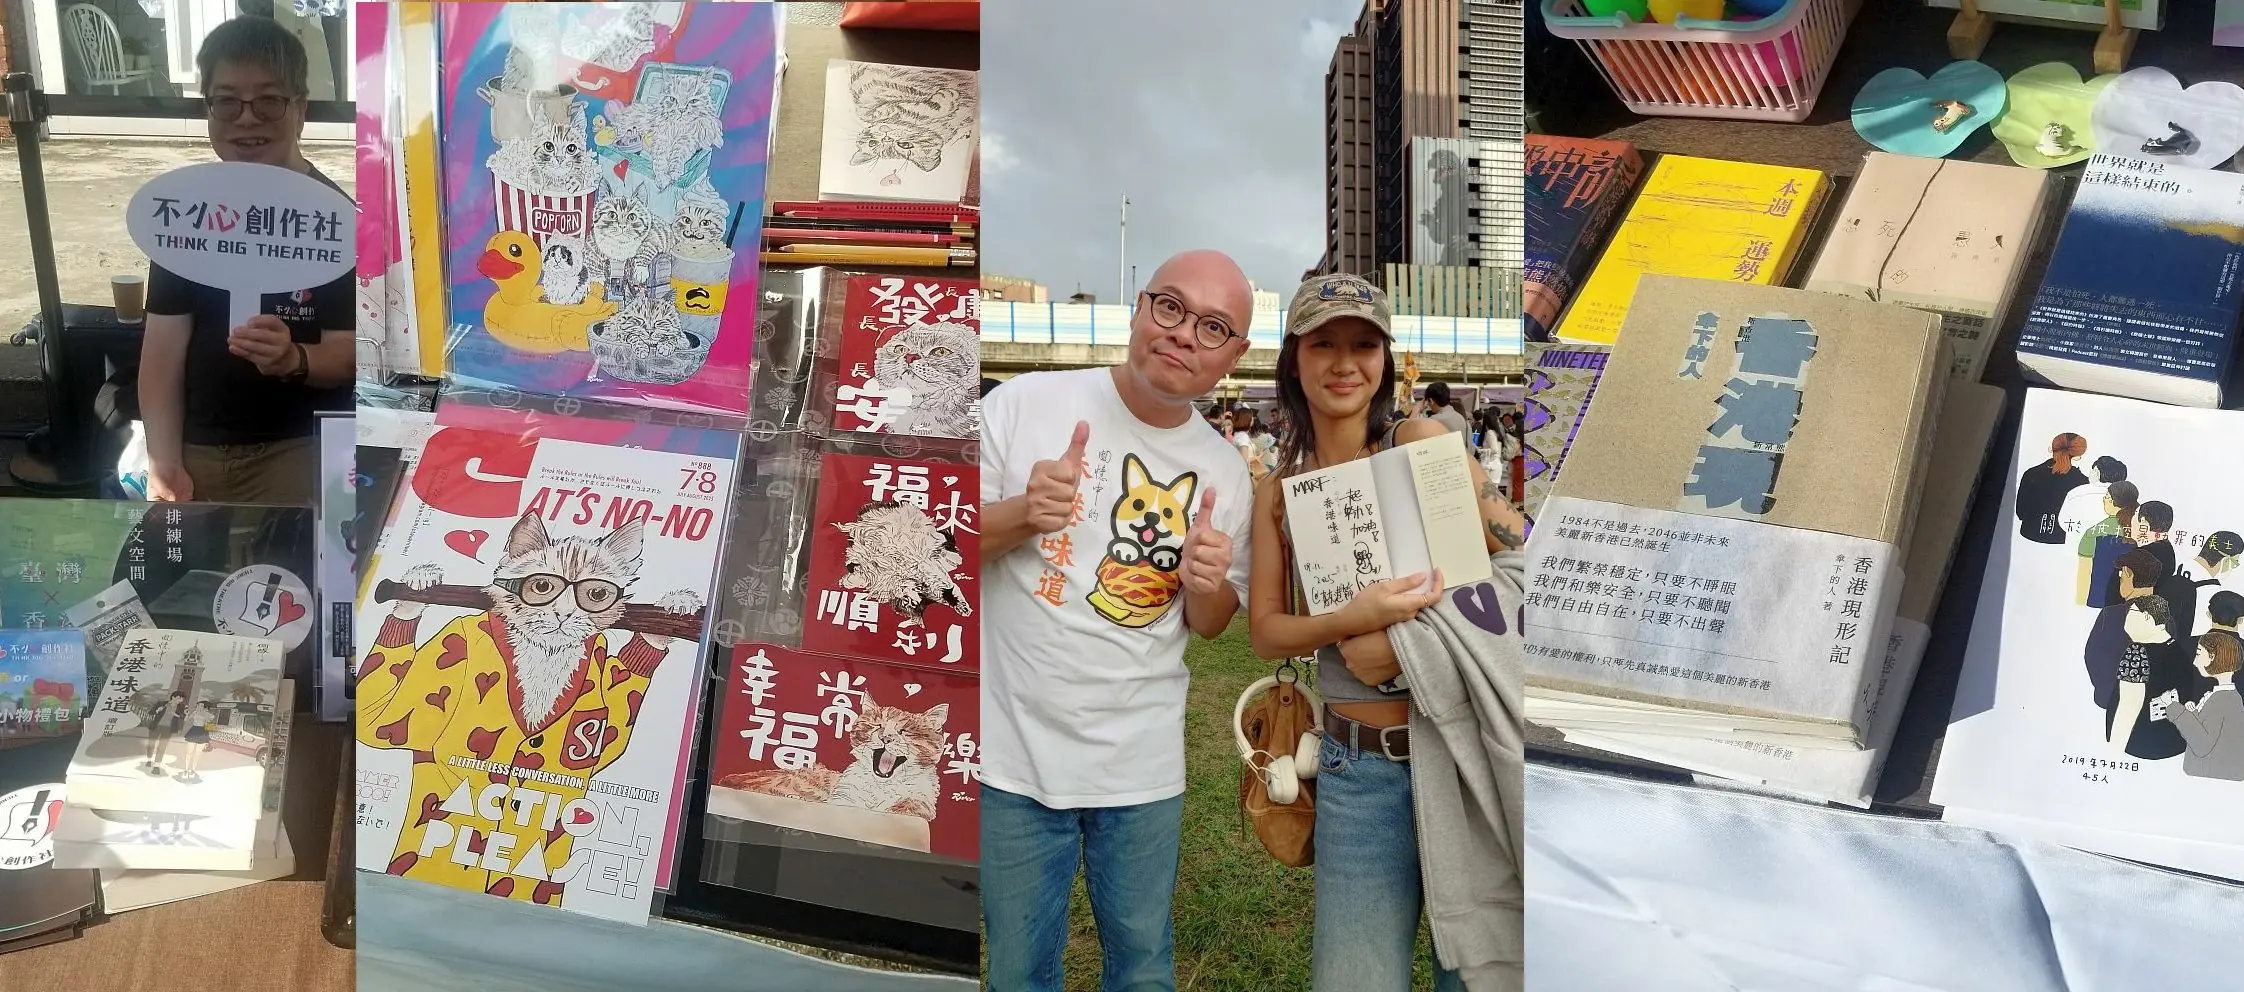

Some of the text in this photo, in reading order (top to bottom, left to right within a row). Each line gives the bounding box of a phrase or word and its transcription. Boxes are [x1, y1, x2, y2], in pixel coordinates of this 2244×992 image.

[2090, 153, 2165, 176] 世界就是
[152, 197, 343, 243] 不小心創作社
[534, 212, 580, 234] POPCORN
[217, 240, 247, 255] BIG
[256, 243, 341, 263] THEATRE
[165, 508, 183, 563] 排練場
[600, 496, 714, 542] NO-NO
[1554, 527, 1672, 553] 美麗新香港已然誕生
[127, 508, 146, 581] 藝文空間
[1541, 555, 1737, 596] 我們繁榮穩定，只要不睜眼
[1526, 592, 1726, 634] 我們自由自在，只要不出聲
[1829, 556, 1873, 665] 香港現形記
[14, 674, 29, 683] or
[101, 638, 155, 714] 香港味道
[447, 755, 660, 804] A LITTLE LESS CONVERSATION, A LITTLE MORE
[438, 775, 652, 857] ACTION,
[418, 818, 645, 900] PLEASE!
